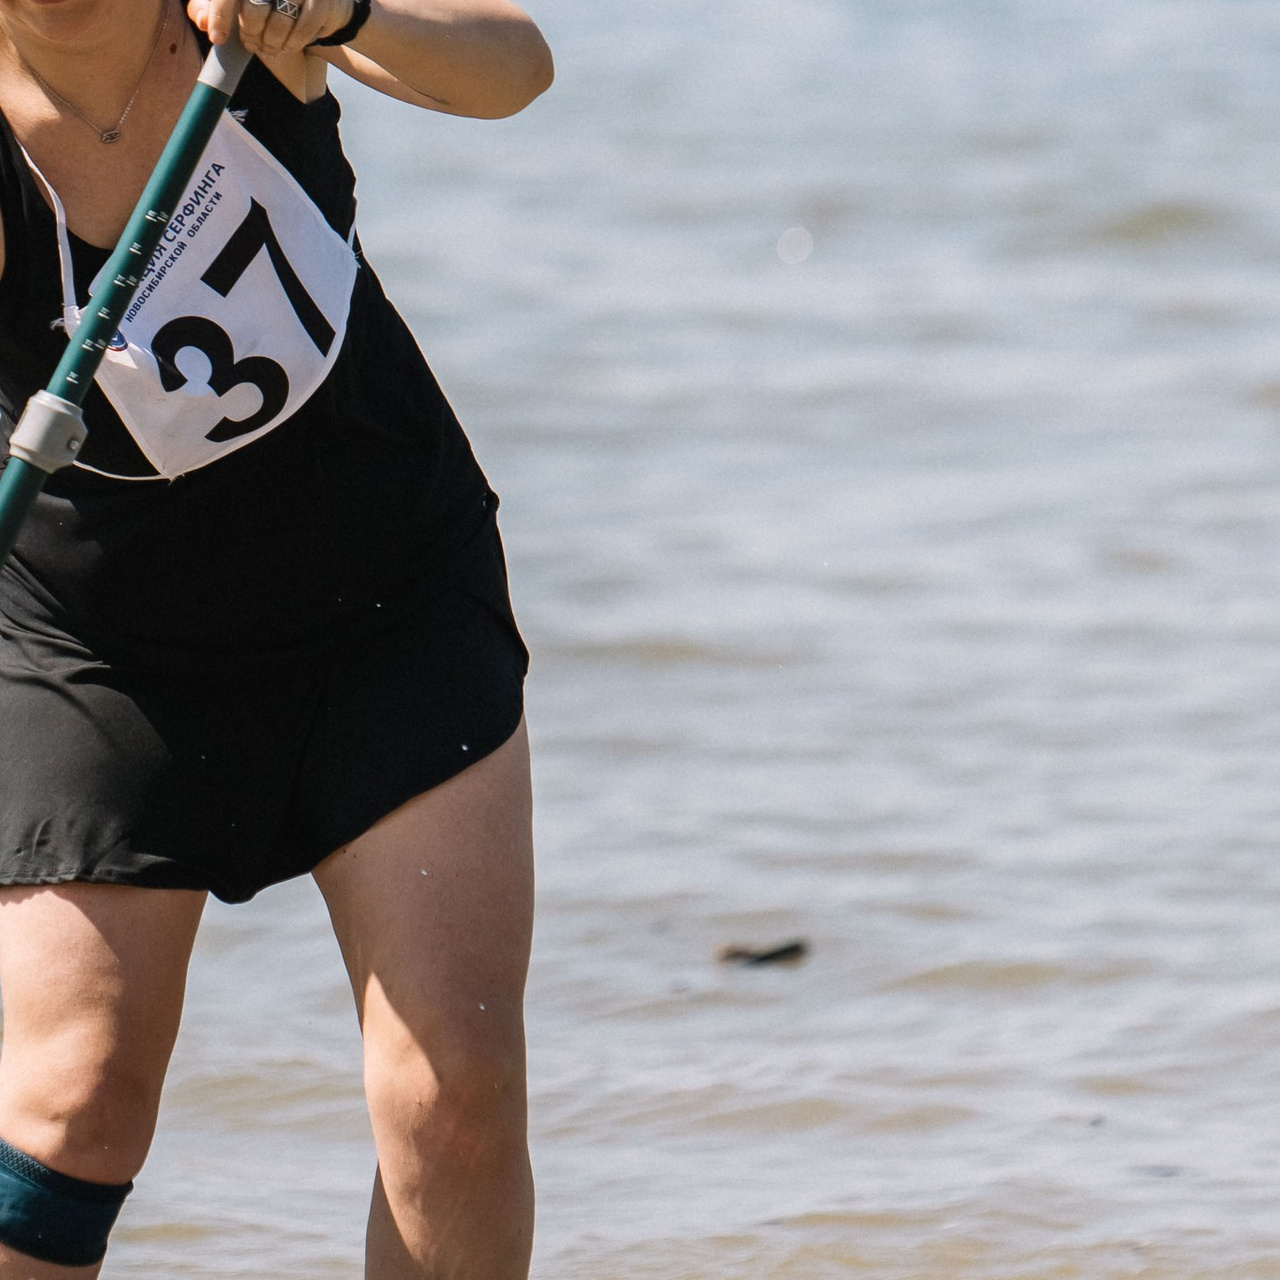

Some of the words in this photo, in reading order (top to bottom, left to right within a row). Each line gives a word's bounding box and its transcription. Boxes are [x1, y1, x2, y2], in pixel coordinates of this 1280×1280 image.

[125, 241, 187, 323] НОВОСИБИРСКОЙ
[187, 191, 223, 238] ОБЛАСТИ
[164, 162, 225, 242] СЕРФИНГА
[151, 195, 336, 443] 37
